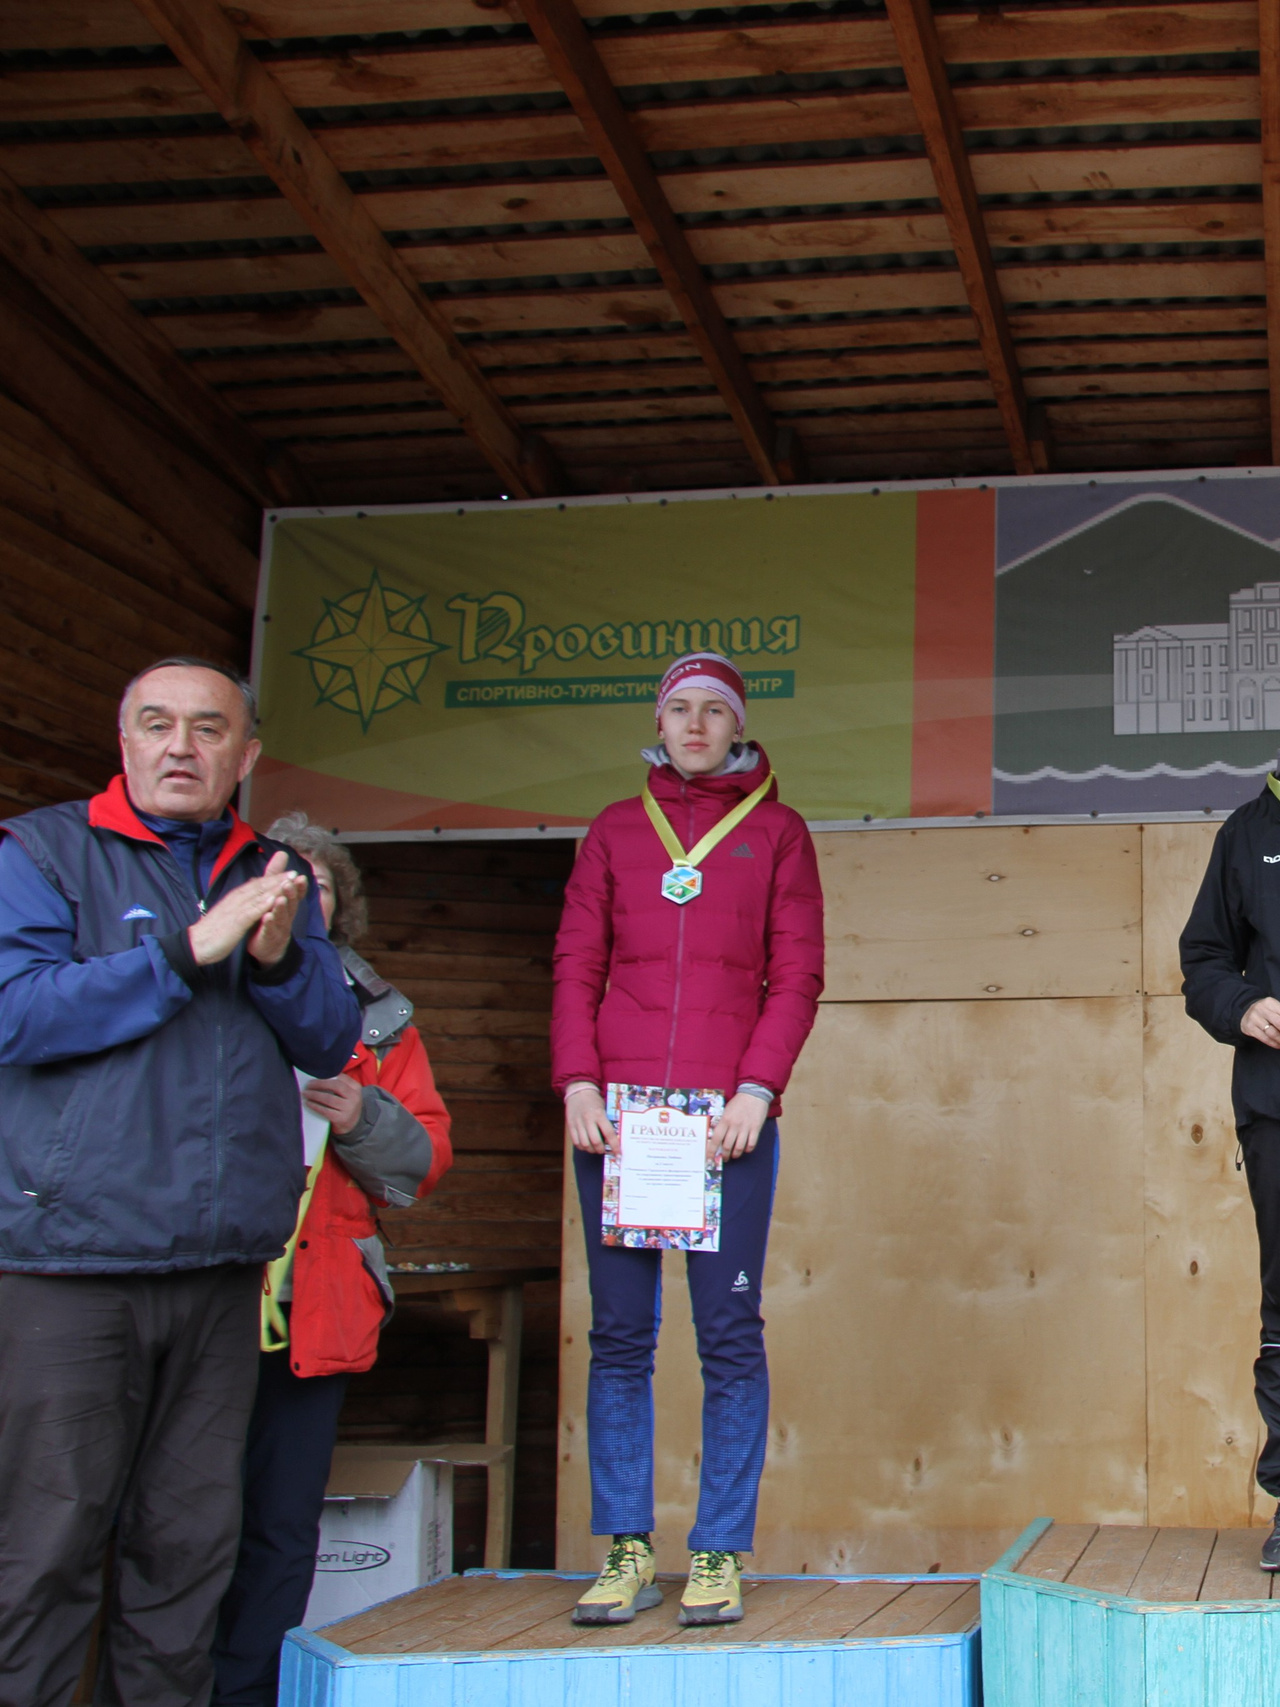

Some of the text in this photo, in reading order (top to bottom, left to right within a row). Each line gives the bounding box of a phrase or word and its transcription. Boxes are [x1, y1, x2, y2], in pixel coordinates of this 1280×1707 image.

[444, 591, 801, 675] Провинция
[456, 681, 659, 702] СПОРТИВНО-ТУРИСТИЧ
[631, 1124, 697, 1138] ГРАМОТА
[342, 1551, 383, 1565] Light
